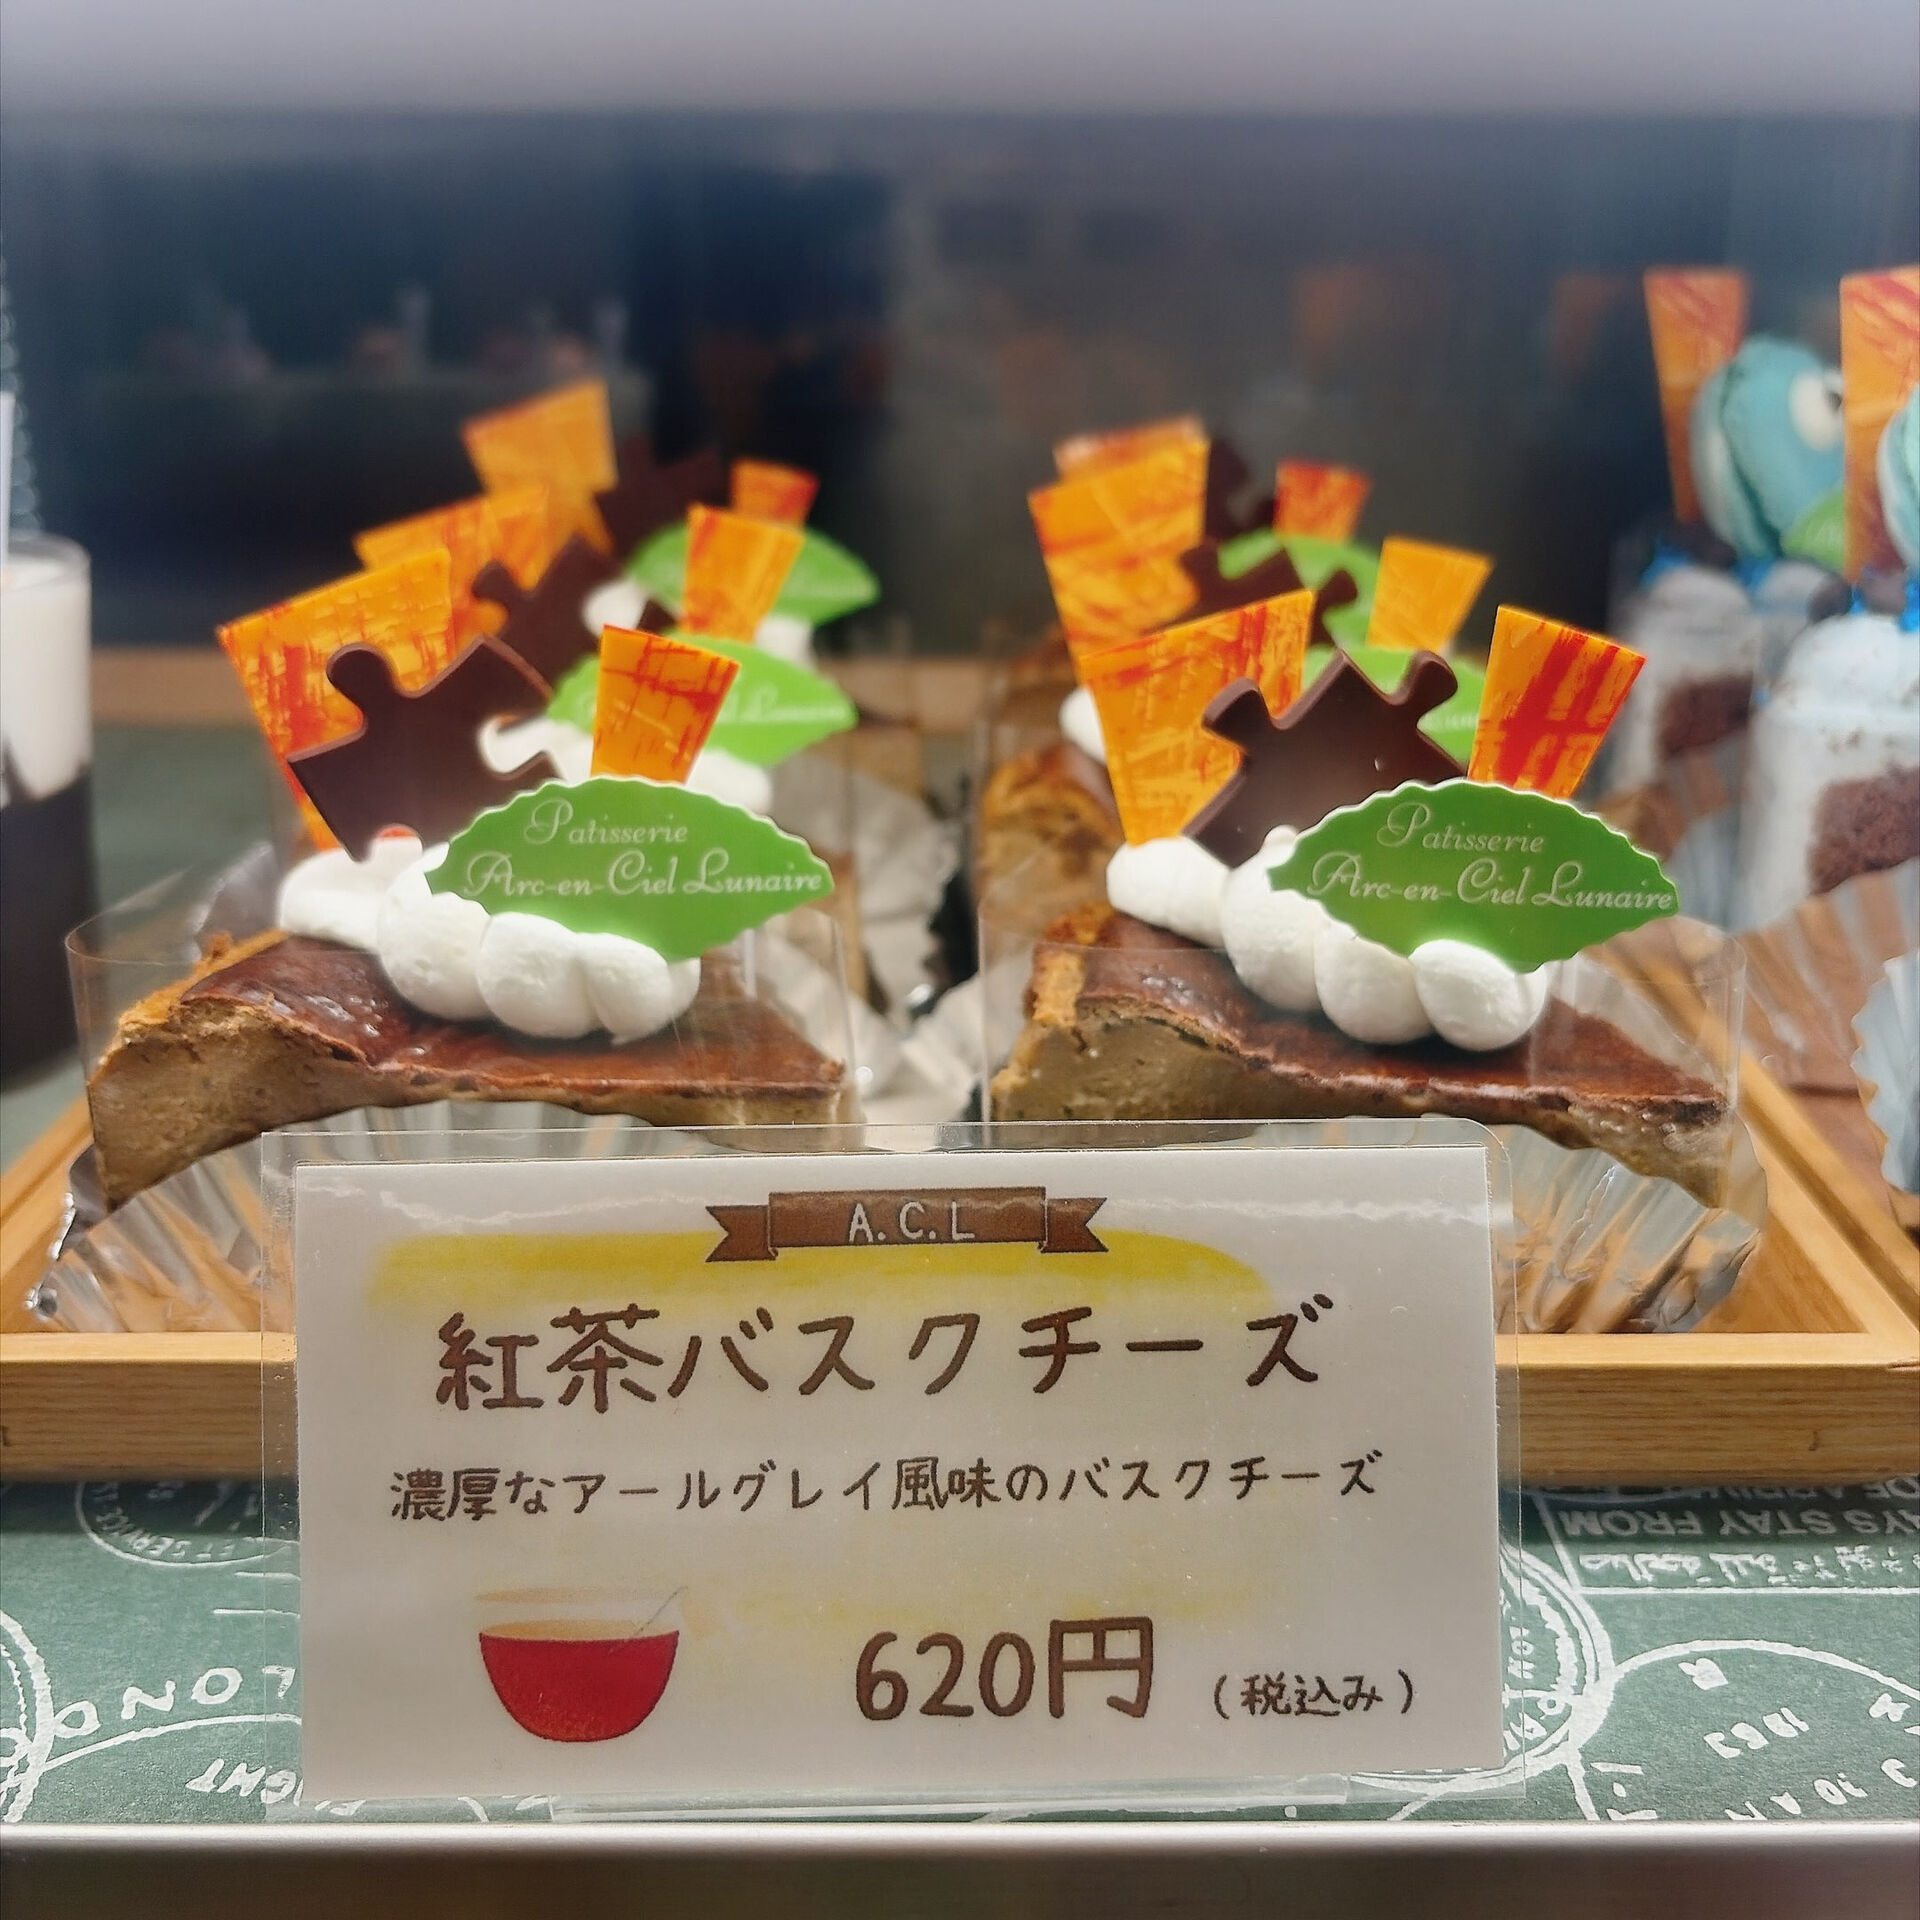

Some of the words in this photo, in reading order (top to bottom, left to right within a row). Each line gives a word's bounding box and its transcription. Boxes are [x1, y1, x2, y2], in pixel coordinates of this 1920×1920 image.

[523, 798, 688, 845] Patisserie
[1376, 802, 1545, 854] Patisserie
[463, 849, 677, 897] Arc-en-Ciel
[683, 847, 822, 894] Lunaire
[1305, 850, 1528, 904] Arc-en-Ciel
[1531, 861, 1673, 909] Lunaire
[849, 1201, 975, 1243] A.C.L
[435, 1293, 1334, 1414] 紅茶バスクチーズ
[390, 1449, 1383, 1522] 濃厚なアールグレイ風味のバスクチーズ
[1557, 1509, 1704, 1536] FROM
[1718, 1509, 1837, 1536] STAY
[856, 1615, 1155, 1720] 620円
[1213, 1669, 1414, 1721] (税込み)
